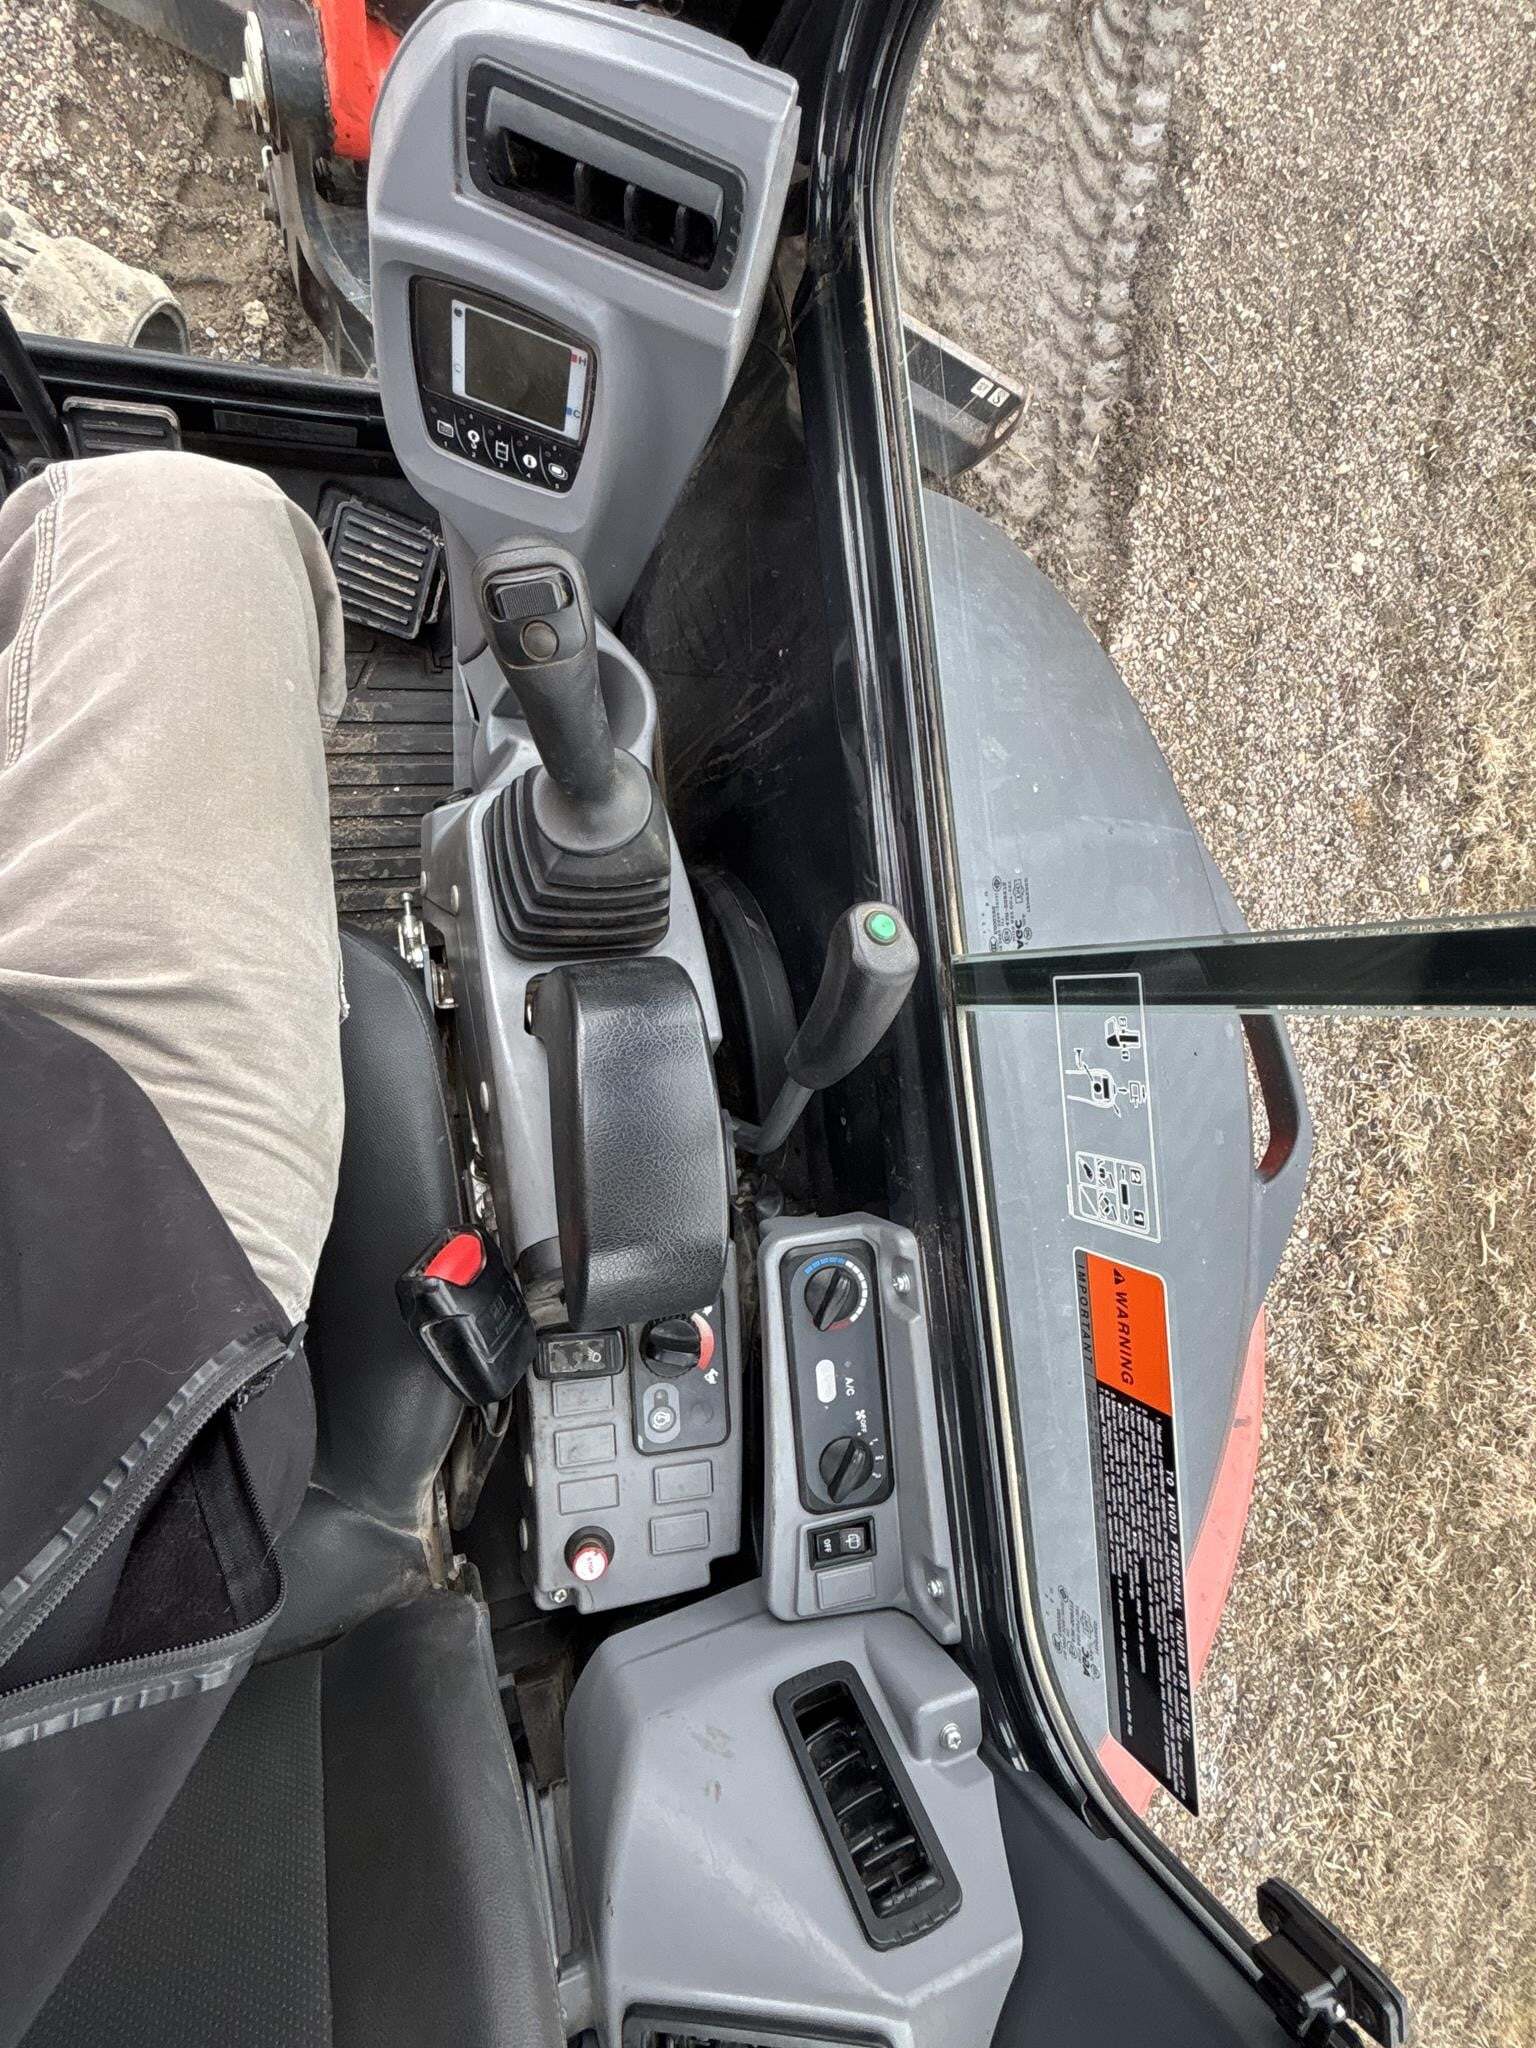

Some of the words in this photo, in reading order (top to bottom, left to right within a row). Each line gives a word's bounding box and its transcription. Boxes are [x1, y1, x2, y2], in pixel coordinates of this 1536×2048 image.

[578, 357, 586, 367] H
[573, 409, 581, 419] C
[1076, 1263, 1092, 1364] IMPORTANT
[1115, 1289, 1133, 1387] WARNING
[844, 1377, 855, 1397] A/C
[1165, 1468, 1174, 1488] TO
[1167, 1492, 1177, 1535] AVOID
[823, 1538, 832, 1553] OFF
[1170, 1539, 1182, 1612] PERSONAL
[1175, 1616, 1185, 1667] INJURY
[1178, 1668, 1187, 1690] OR
